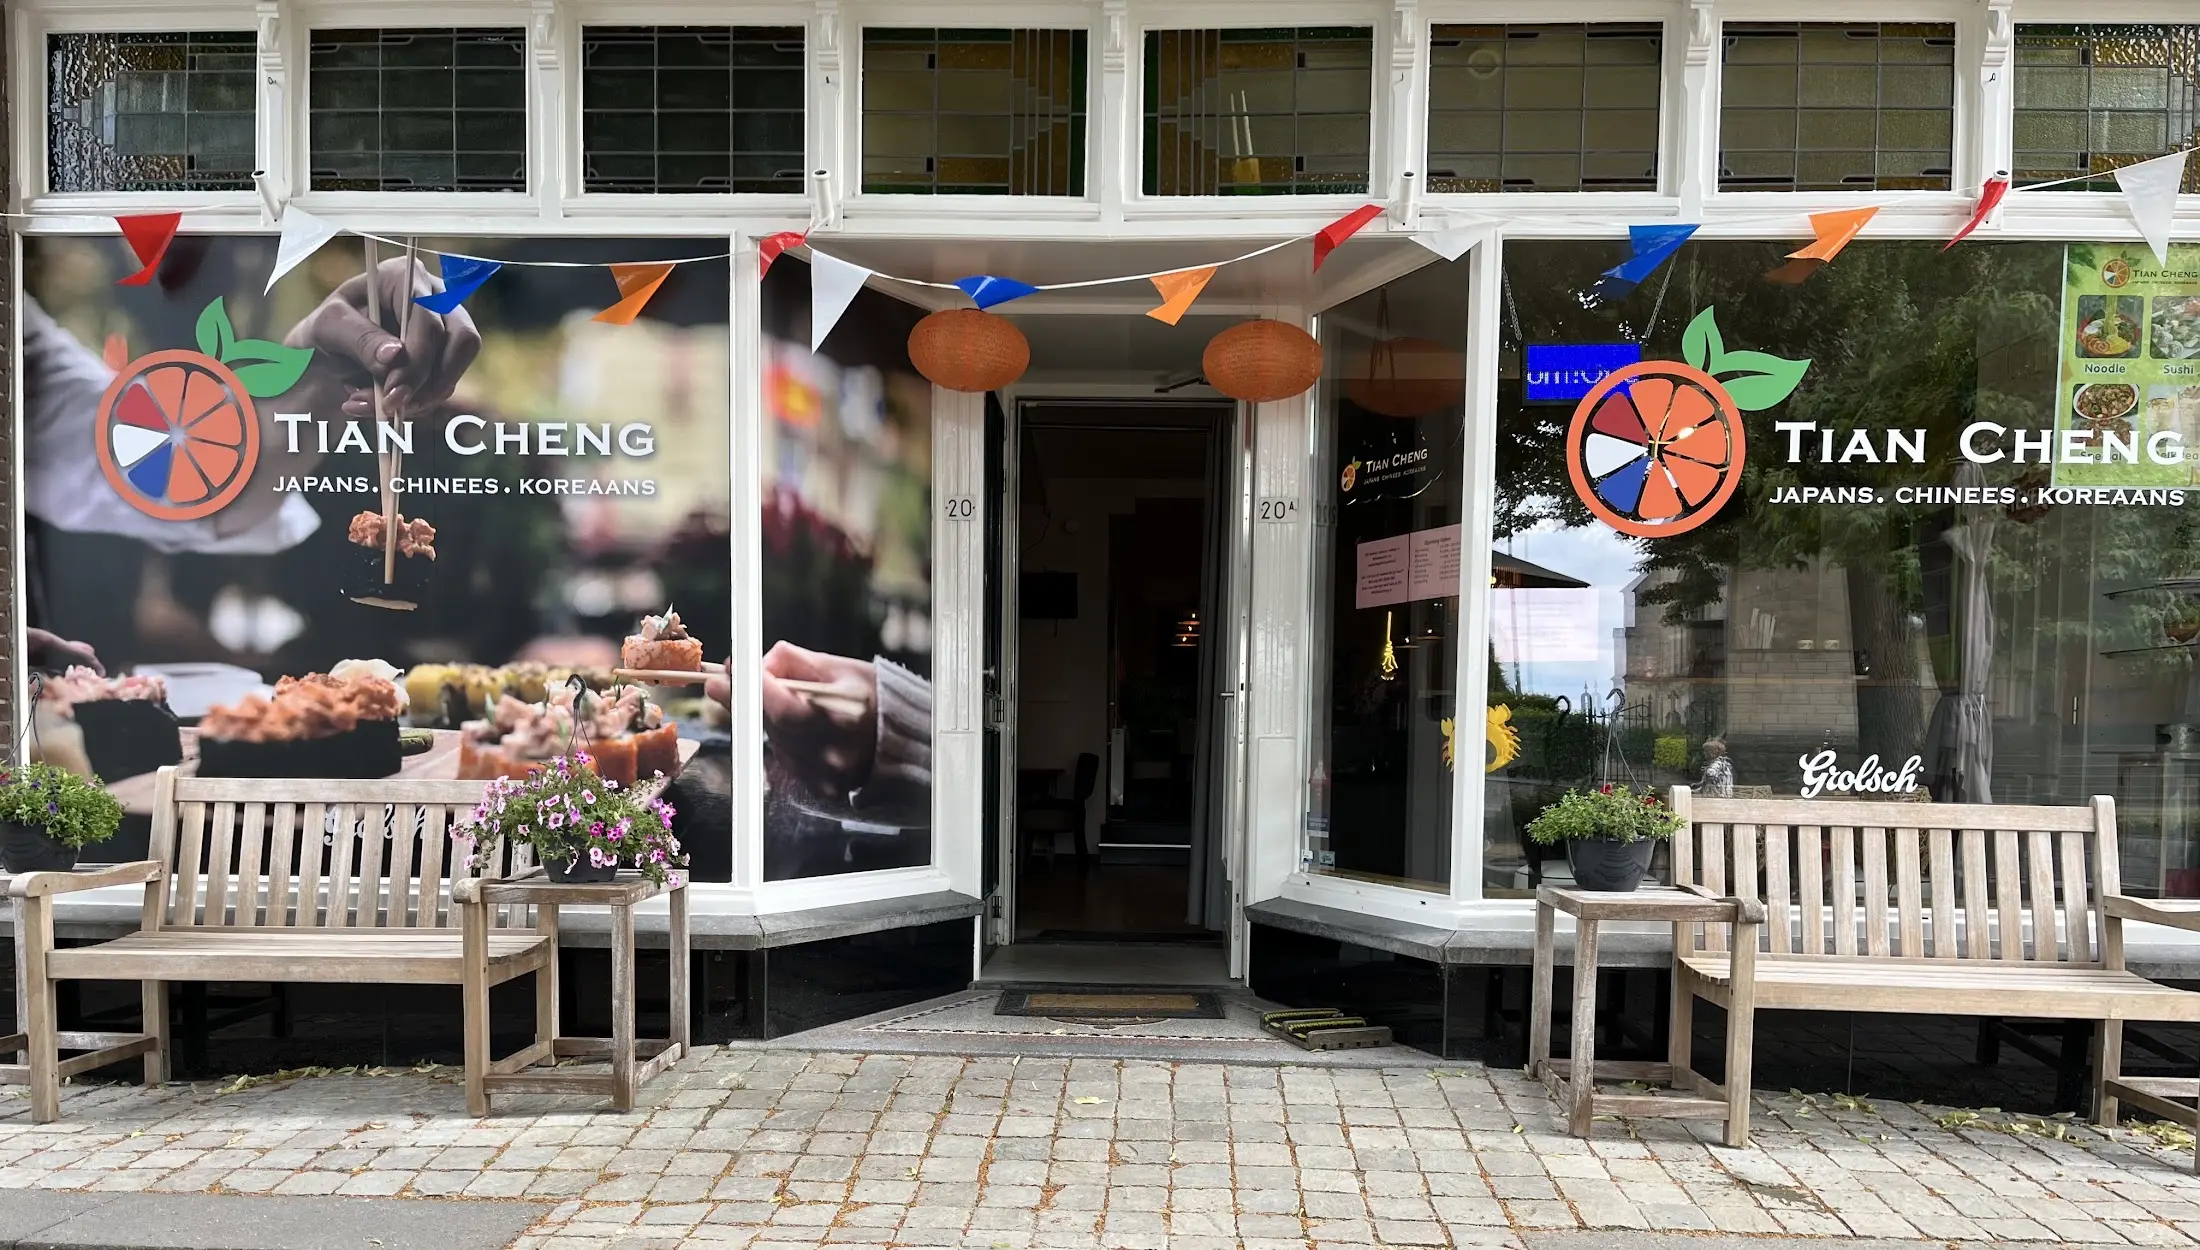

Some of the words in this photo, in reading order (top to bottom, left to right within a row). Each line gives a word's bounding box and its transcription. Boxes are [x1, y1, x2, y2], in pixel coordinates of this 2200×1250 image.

[2133, 269, 2157, 278] TIAN
[2161, 270, 2198, 278] CHENG
[2084, 364, 2126, 374] Noodle
[2163, 365, 2194, 374] Sushi
[273, 411, 415, 455] TIAN
[444, 414, 655, 457] CHENG
[1775, 420, 1926, 464] TIAN
[1959, 421, 2186, 466] CHENG
[1366, 458, 1390, 473] TIAN
[1392, 448, 1428, 467] CHENG
[519, 478, 656, 495] KOREAANS
[2037, 488, 2185, 506] KOREAANS
[948, 499, 972, 517] 20
[1261, 501, 1295, 520] 20A
[1798, 749, 1925, 799] Grolsch
